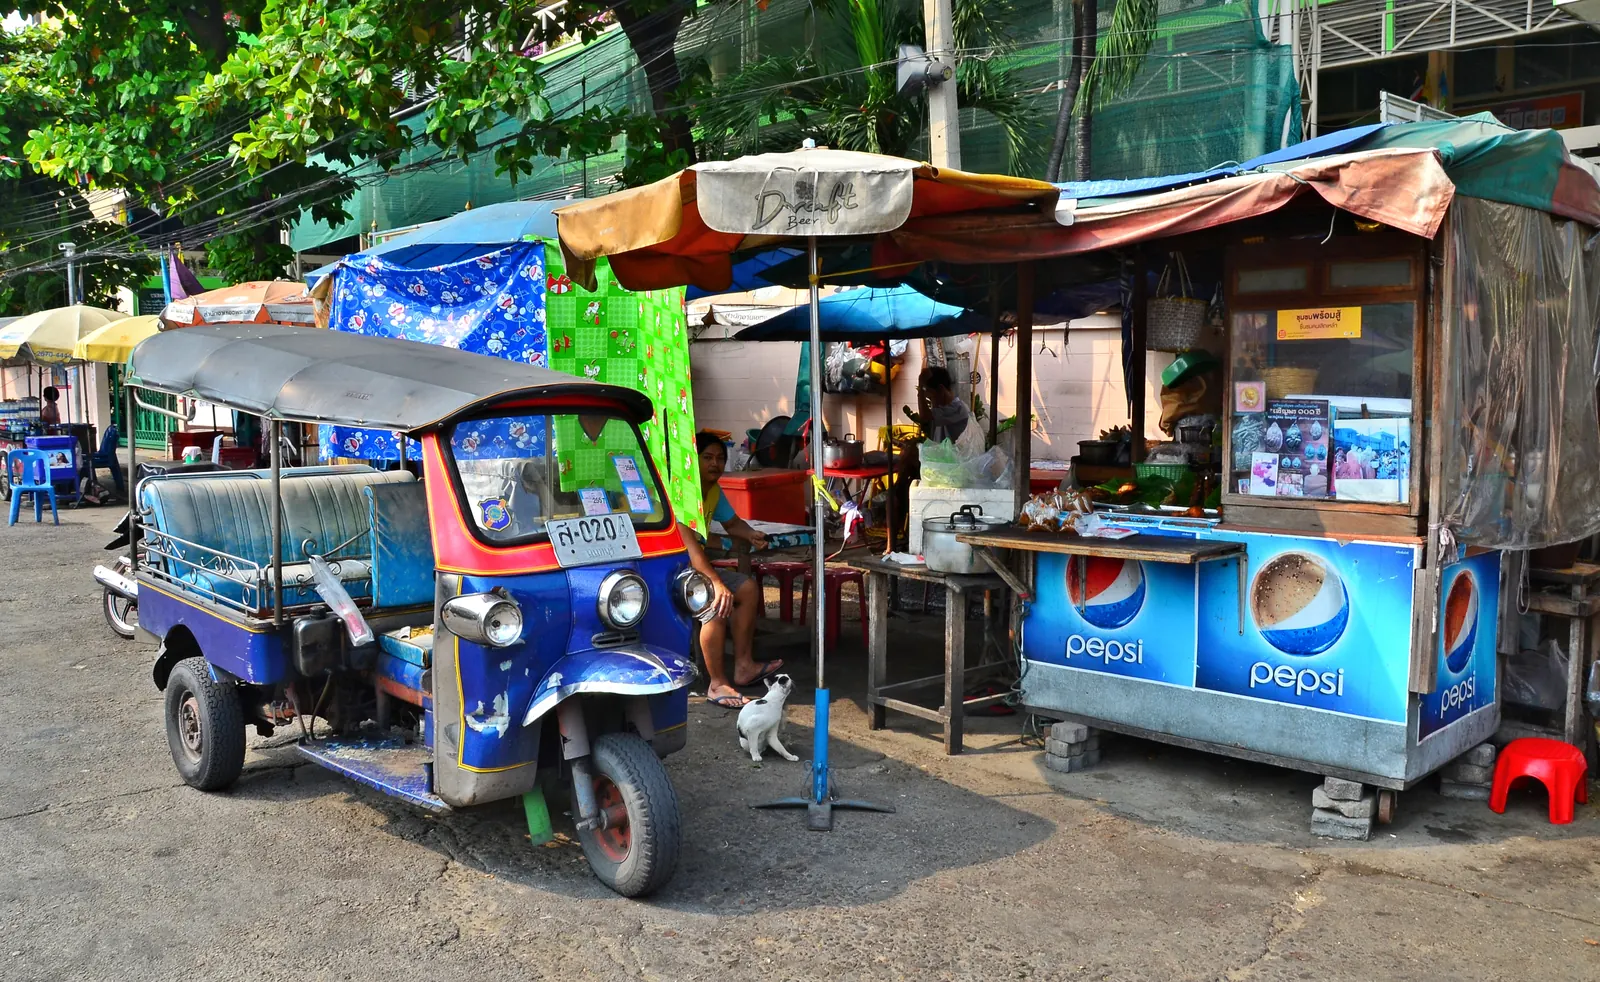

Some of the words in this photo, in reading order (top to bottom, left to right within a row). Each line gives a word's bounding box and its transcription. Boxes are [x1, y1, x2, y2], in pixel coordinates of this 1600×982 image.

[752, 181, 859, 230] Draft
[787, 215, 819, 230] Beer
[1065, 633, 1144, 665] pepsi
[1249, 660, 1345, 697] pepsi
[1440, 669, 1476, 719] pepsi
